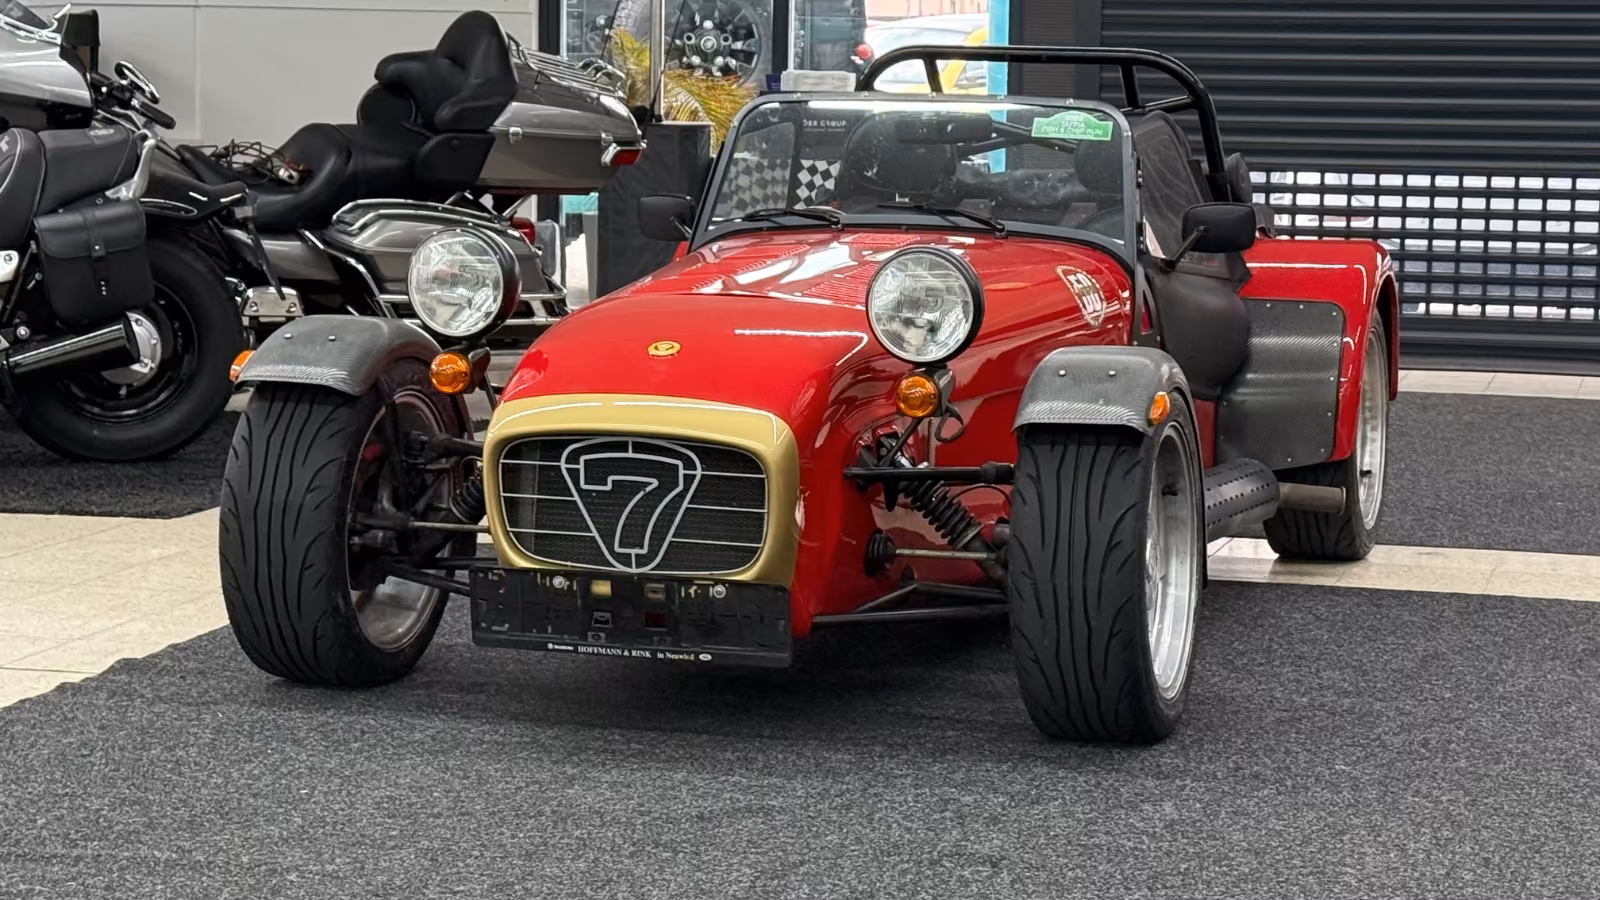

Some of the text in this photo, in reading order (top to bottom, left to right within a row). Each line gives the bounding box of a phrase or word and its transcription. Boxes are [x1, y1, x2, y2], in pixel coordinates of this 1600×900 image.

[580, 453, 683, 554] 7
[577, 646, 622, 656] HOFFMANN
[623, 649, 630, 657] &
[631, 649, 652, 658] RINK
[657, 651, 664, 659] in
